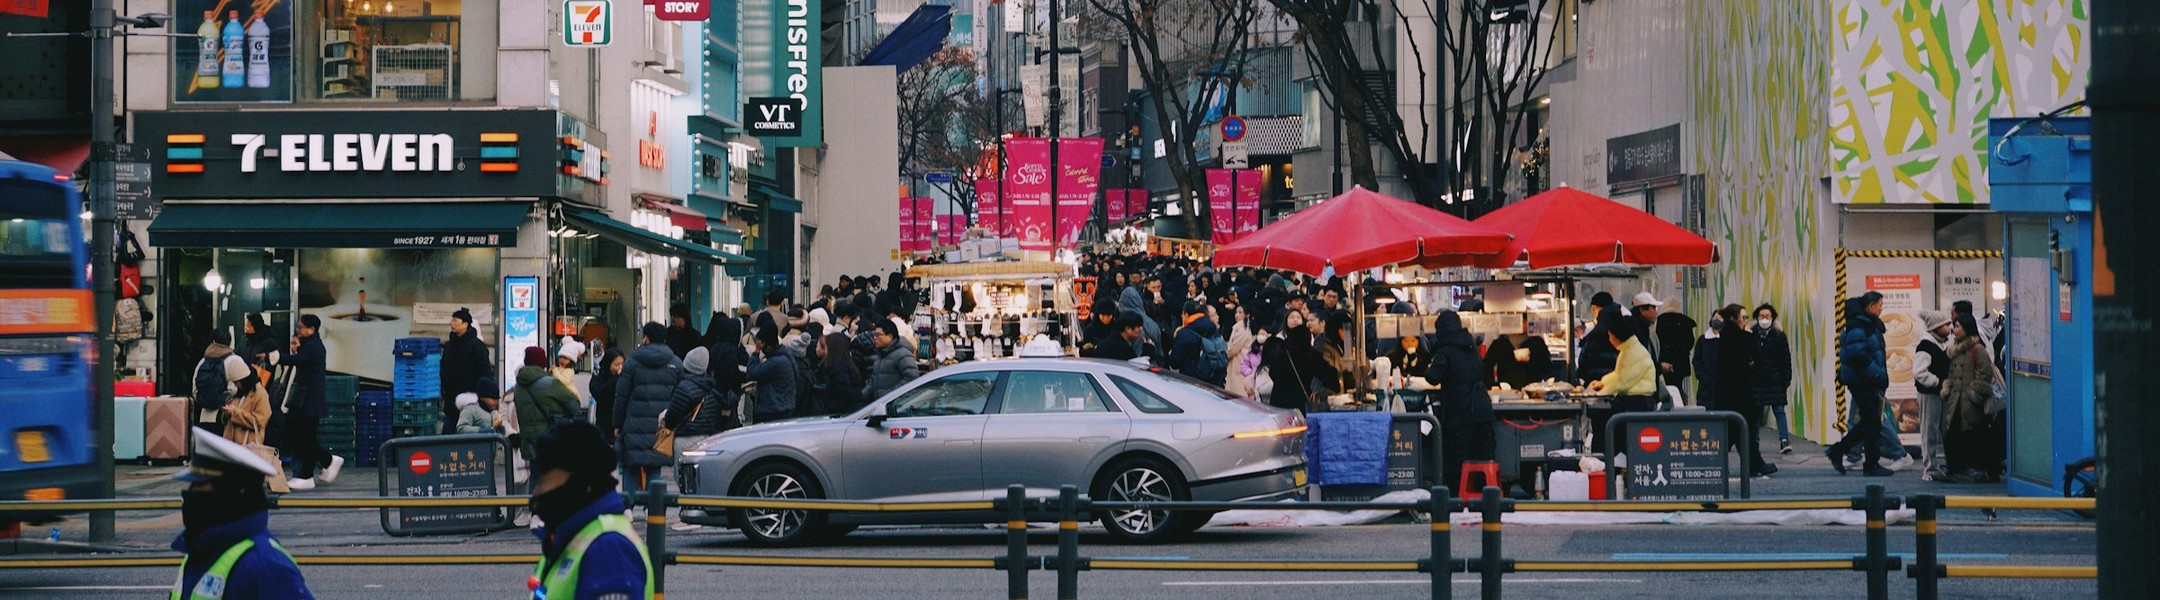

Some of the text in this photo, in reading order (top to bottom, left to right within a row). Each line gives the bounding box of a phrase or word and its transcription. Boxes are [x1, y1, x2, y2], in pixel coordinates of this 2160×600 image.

[664, 1, 700, 14] STORY
[575, 5, 601, 43] 7
[254, 40, 263, 51] G
[759, 104, 791, 122] VT
[754, 121, 796, 130] COSMETICS
[1012, 166, 1047, 185] Sale
[393, 237, 414, 245] SINCE
[414, 236, 434, 245] 1927
[467, 236, 487, 245] 편의점
[1634, 464, 1653, 475] 걷자,
[1669, 470, 1722, 479] 매일 10:00~23:00
[1634, 475, 1651, 487] 서울
[406, 486, 424, 496] 걷자,
